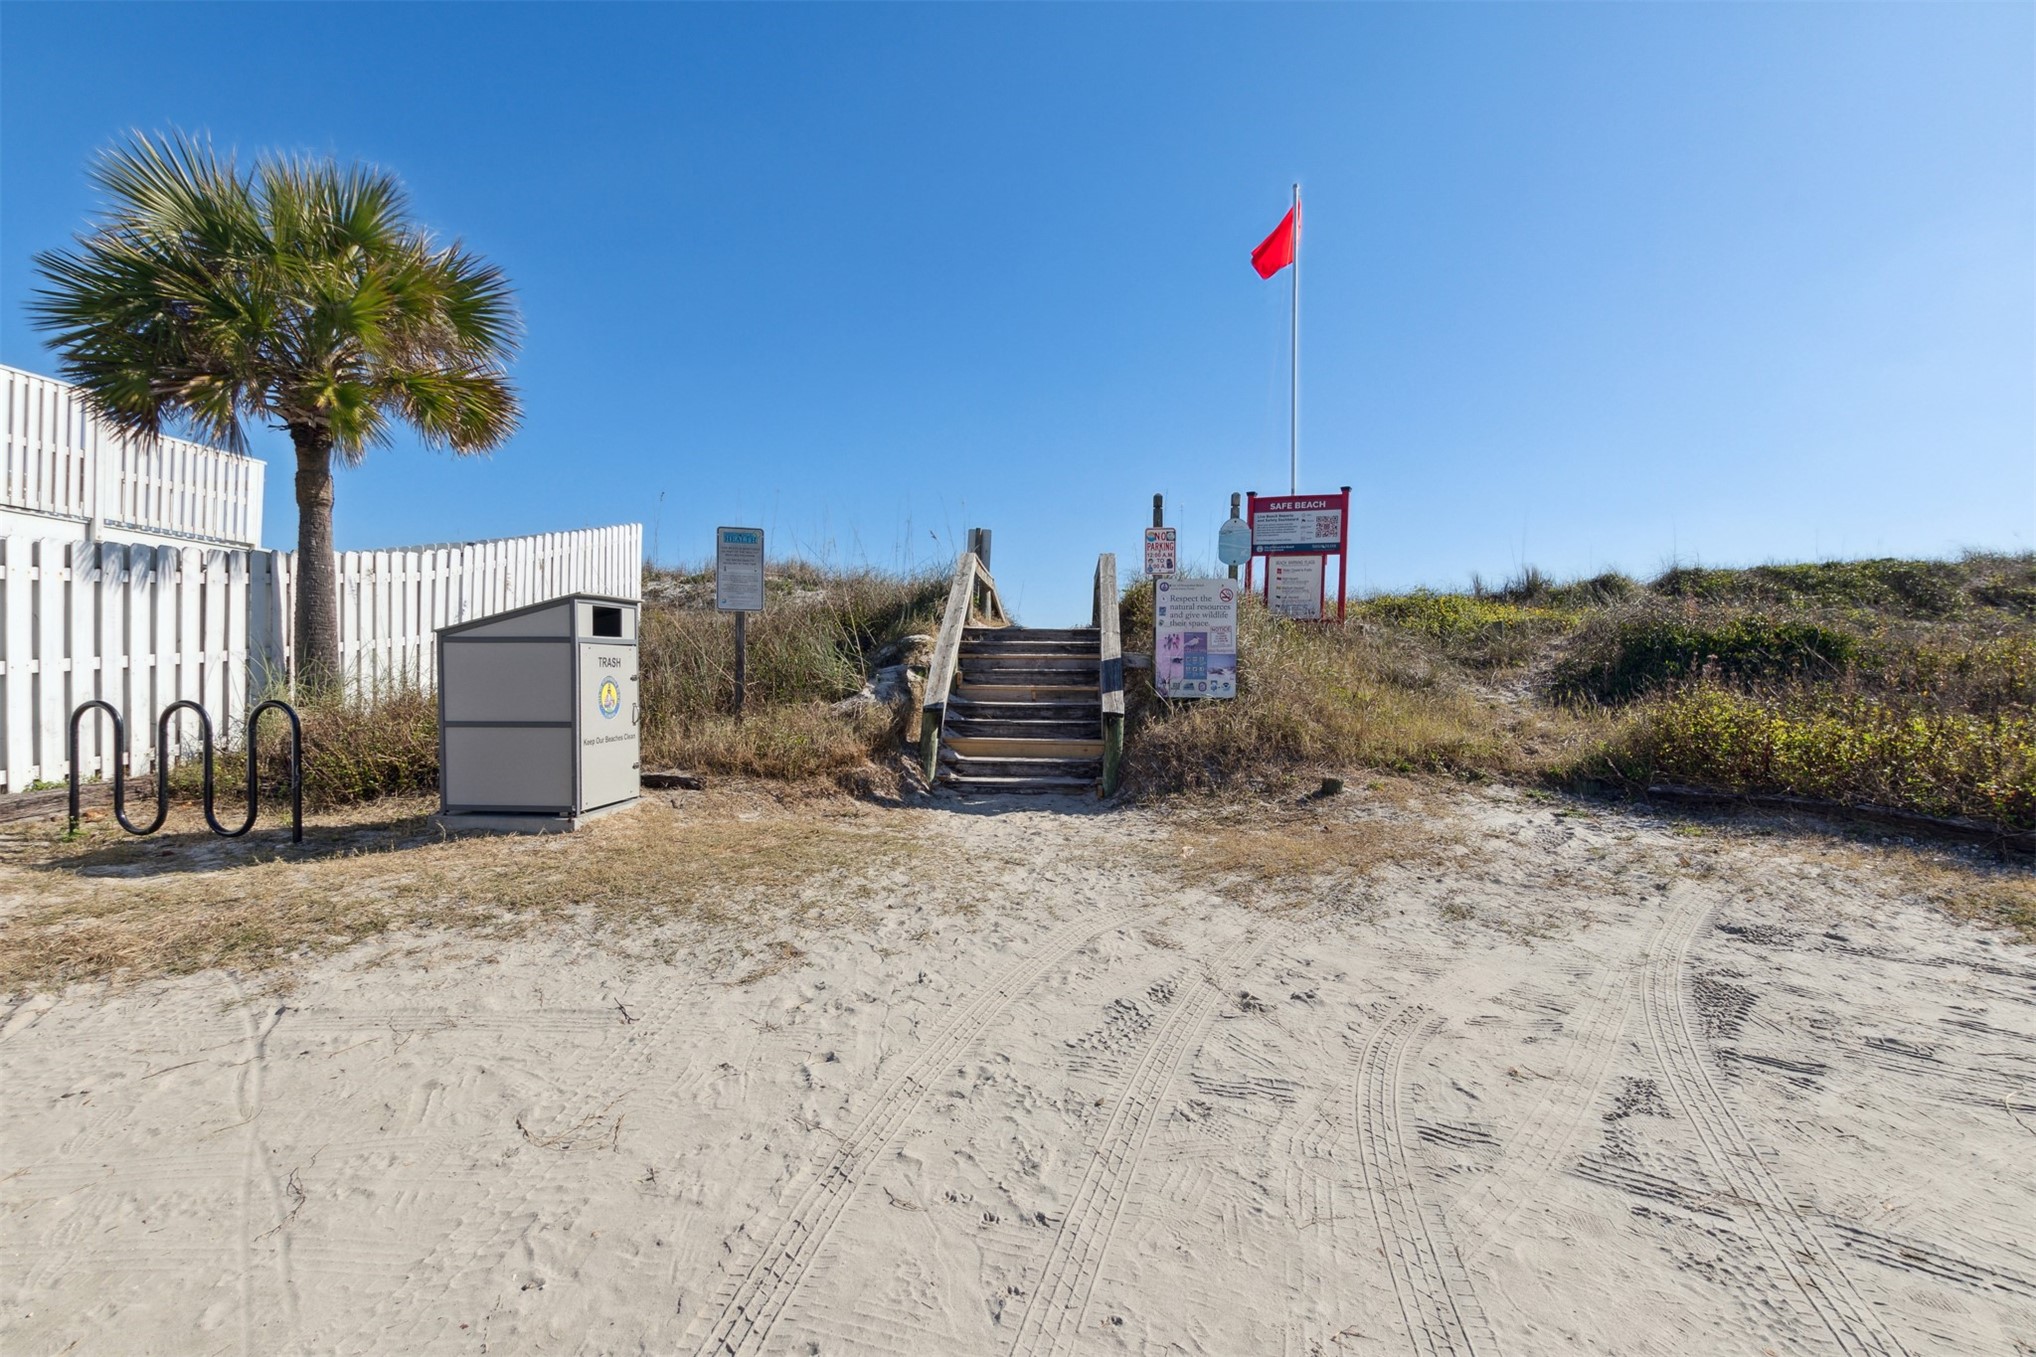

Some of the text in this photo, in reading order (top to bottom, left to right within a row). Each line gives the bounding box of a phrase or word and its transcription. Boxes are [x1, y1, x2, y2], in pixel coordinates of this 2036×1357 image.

[1294, 501, 1326, 509] BEACH
[1154, 532, 1166, 540] NO
[1146, 542, 1174, 551] PARKING
[1170, 595, 1198, 604] Respect
[1185, 612, 1200, 620] give
[598, 657, 621, 668] TRASH
[584, 738, 595, 746] Keep
[605, 735, 623, 743] Beaches
